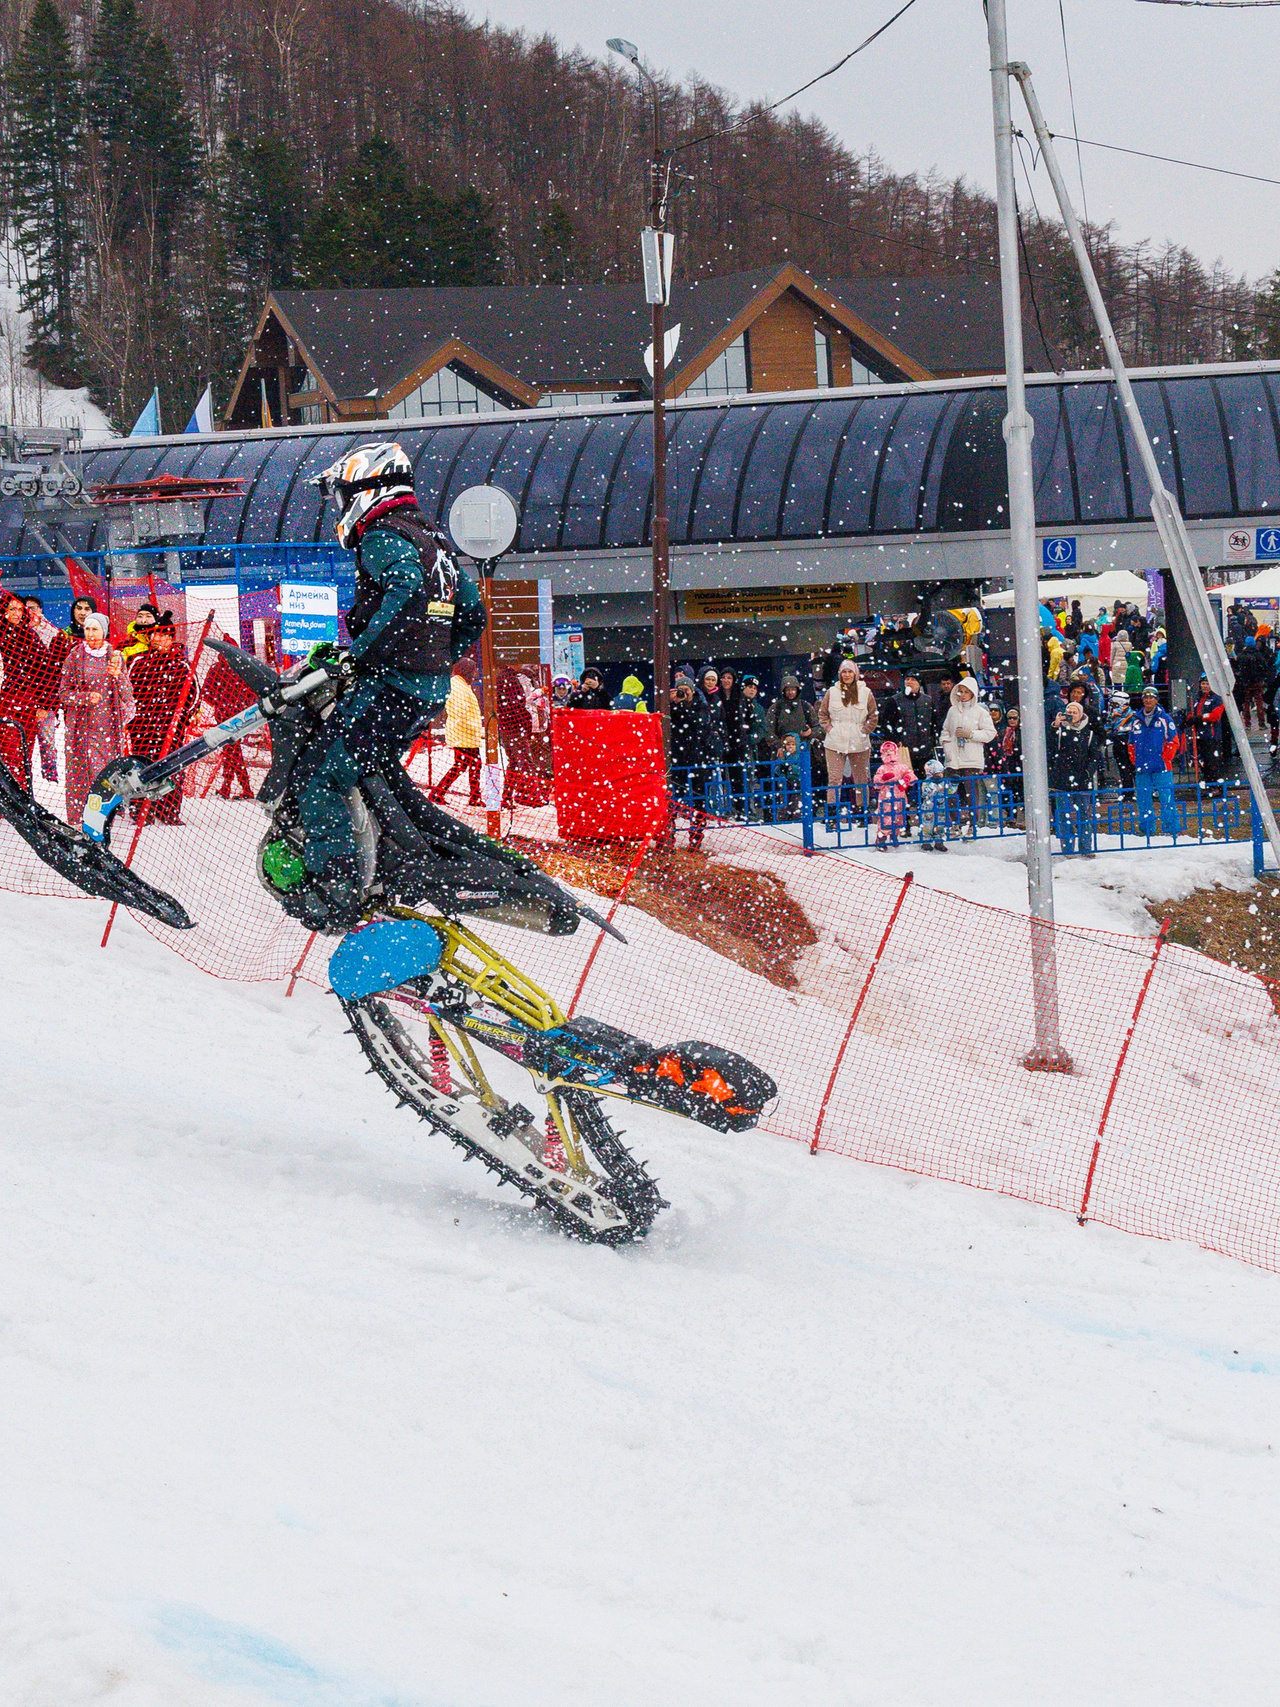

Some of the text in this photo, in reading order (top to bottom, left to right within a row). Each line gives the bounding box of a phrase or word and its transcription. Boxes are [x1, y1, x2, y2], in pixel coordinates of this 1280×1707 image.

[289, 589, 330, 601] Армейка
[289, 601, 305, 610] низ
[703, 605, 740, 615] Gondola
[742, 603, 785, 614] boarding
[803, 602, 841, 611] persons
[463, 1016, 527, 1044] TIMBERSLED
